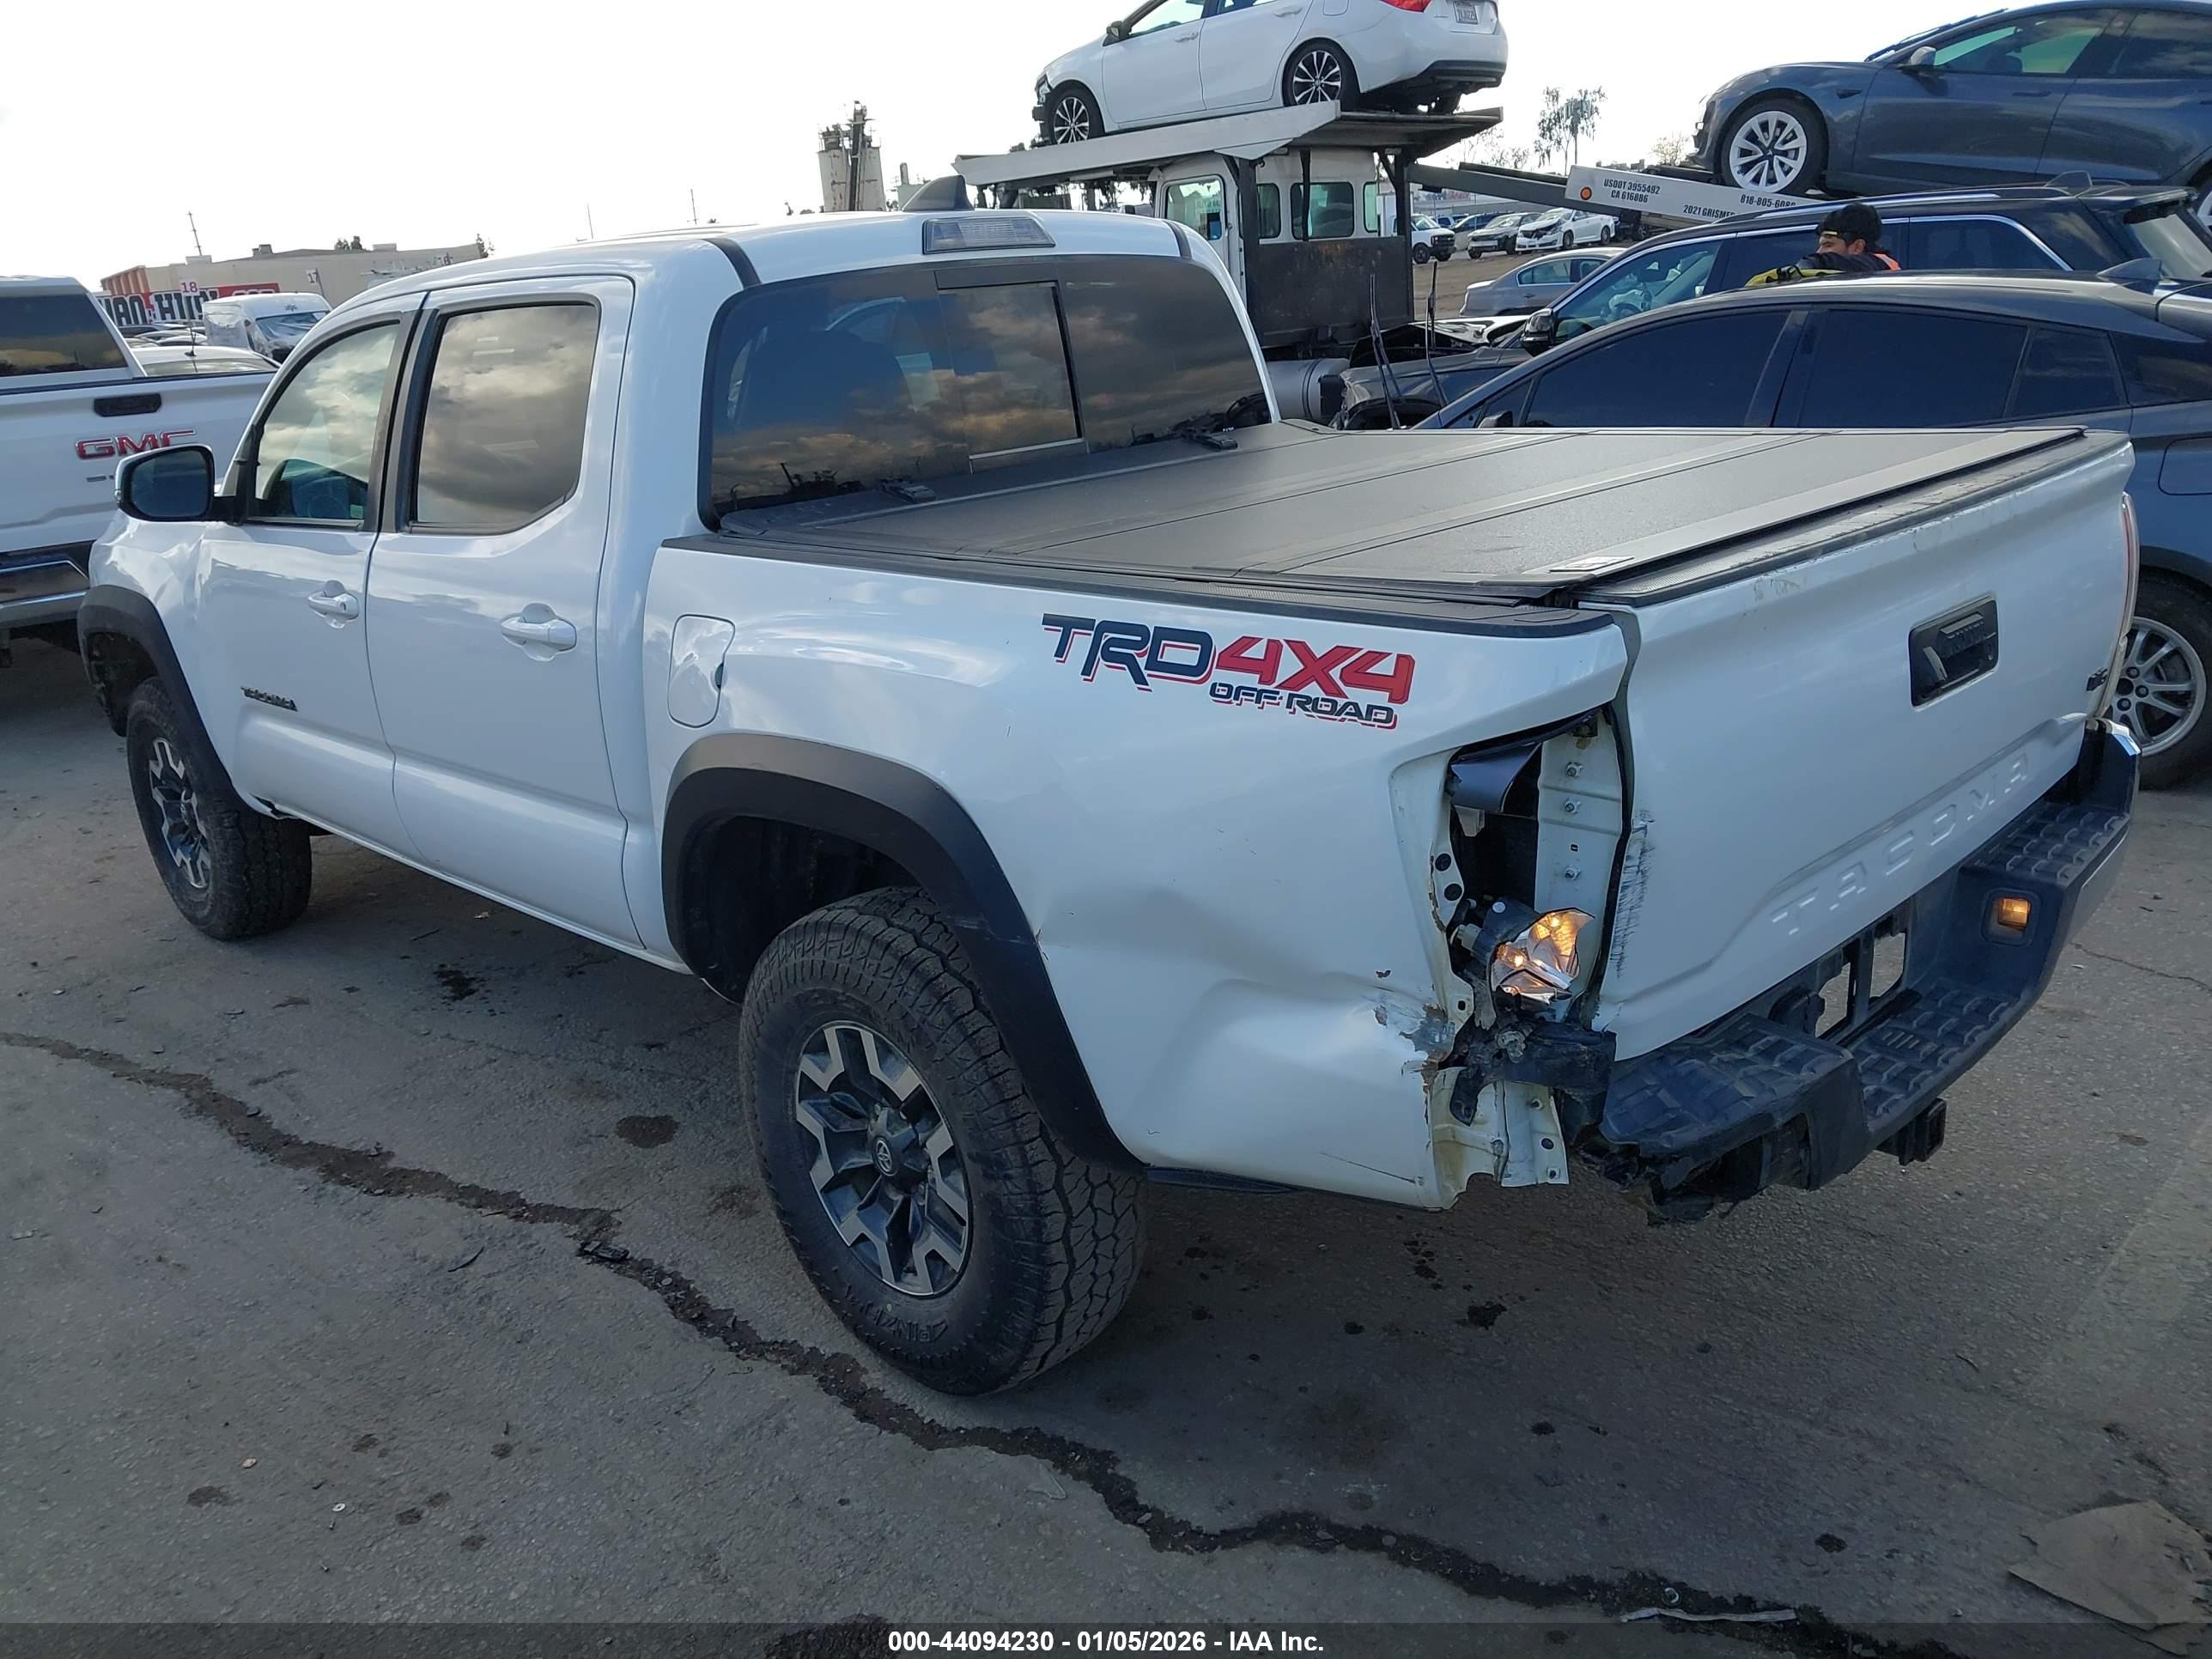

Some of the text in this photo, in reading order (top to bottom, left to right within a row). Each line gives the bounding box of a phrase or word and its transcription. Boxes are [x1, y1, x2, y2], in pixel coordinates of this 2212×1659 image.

[1604, 178, 1661, 195] USDOT 3955492
[1611, 189, 1620, 199] CA
[1683, 204, 1701, 216] 2021
[181, 282, 198, 294] 18
[1042, 613, 1218, 692] TRD
[1209, 682, 1398, 730] OFF ROAD
